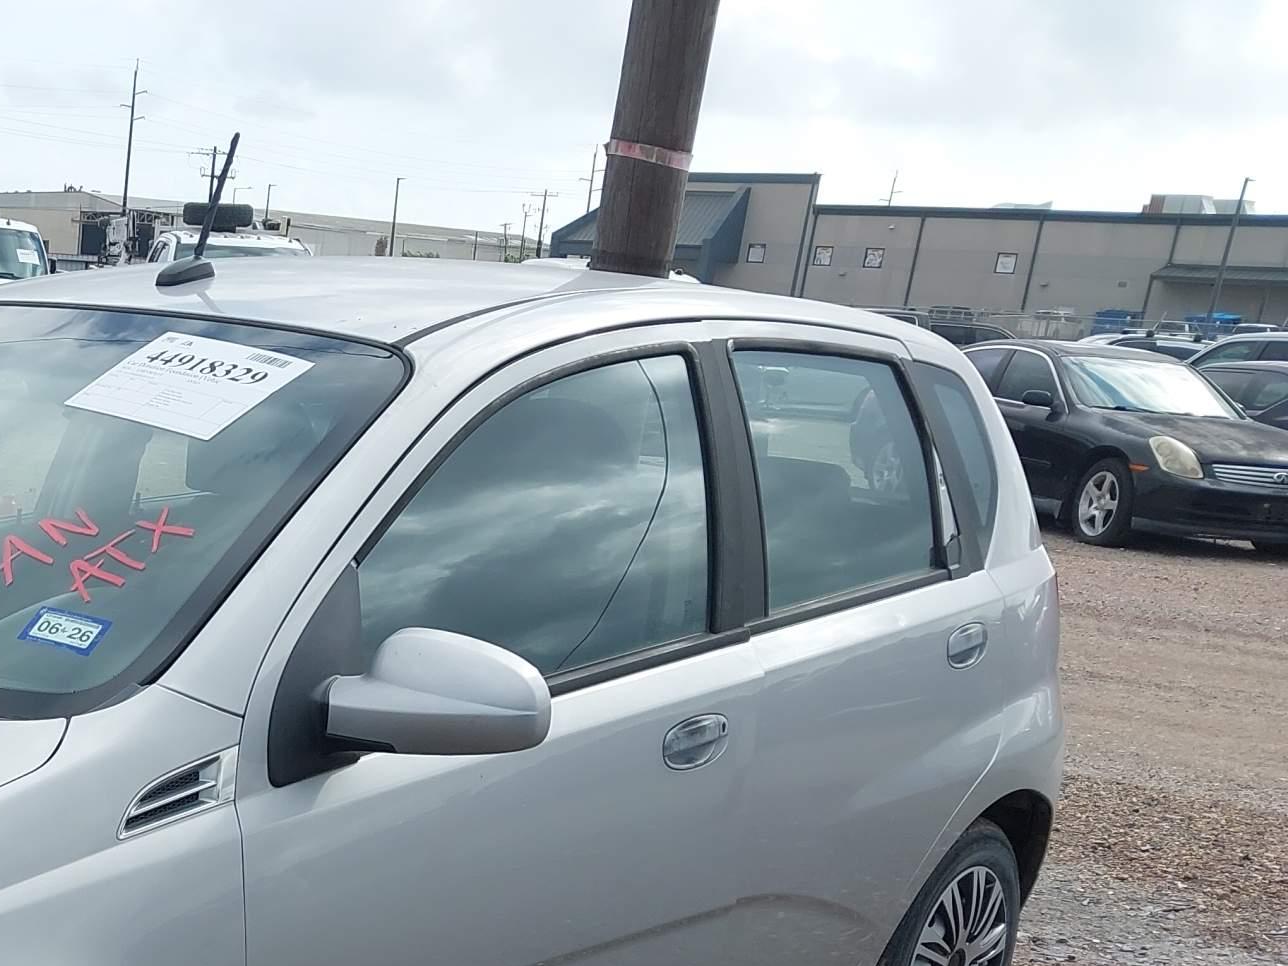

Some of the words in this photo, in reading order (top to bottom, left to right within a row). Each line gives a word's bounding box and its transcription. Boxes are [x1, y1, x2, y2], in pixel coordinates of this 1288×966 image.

[145, 349, 269, 385] 44918329
[69, 506, 195, 603] ATX
[37, 620, 63, 635] 06
[67, 627, 94, 643] 26
